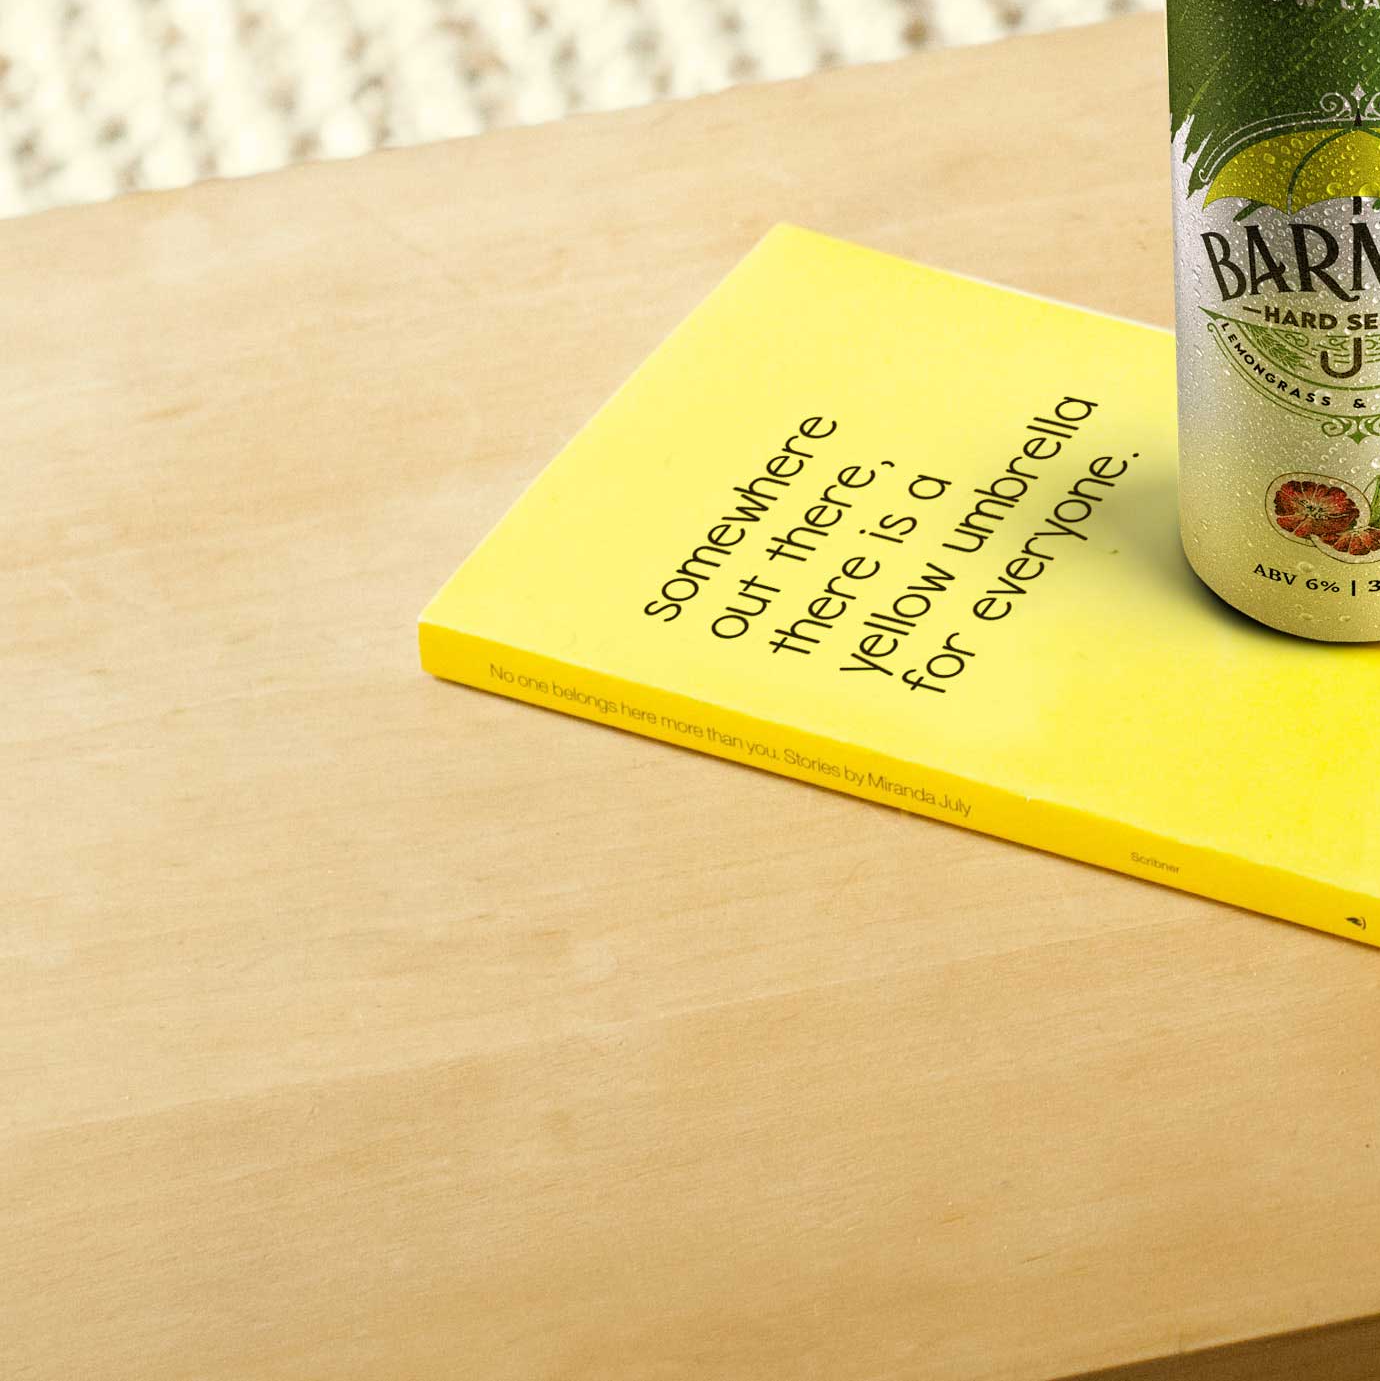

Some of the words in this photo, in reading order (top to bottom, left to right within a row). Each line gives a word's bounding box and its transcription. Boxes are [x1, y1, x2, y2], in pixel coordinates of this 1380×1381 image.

[1220, 321, 1332, 407] LEMONGRASS
[1353, 397, 1367, 409] &
[1264, 305, 1339, 331] HARD
[643, 415, 838, 622] somewhere
[710, 574, 781, 640] out
[765, 460, 895, 562] there,
[768, 555, 881, 655] there
[858, 513, 918, 544] is
[908, 473, 952, 500] a
[839, 562, 956, 677] yellow
[942, 395, 1099, 553] umbrella
[901, 632, 976, 694] for
[972, 451, 1140, 621] everyone.
[1253, 563, 1297, 587] ABV
[1305, 578, 1341, 594] 6%
[489, 663, 515, 684] No
[517, 675, 549, 694] one
[552, 681, 618, 713] belongs
[620, 699, 657, 724] here
[660, 715, 704, 738] more
[706, 727, 743, 749] than
[746, 741, 781, 761] you.
[783, 748, 841, 778] Stories
[843, 764, 865, 787] by
[867, 772, 936, 805] Miranda
[938, 793, 972, 818] July
[1129, 850, 1181, 874] Scribner
